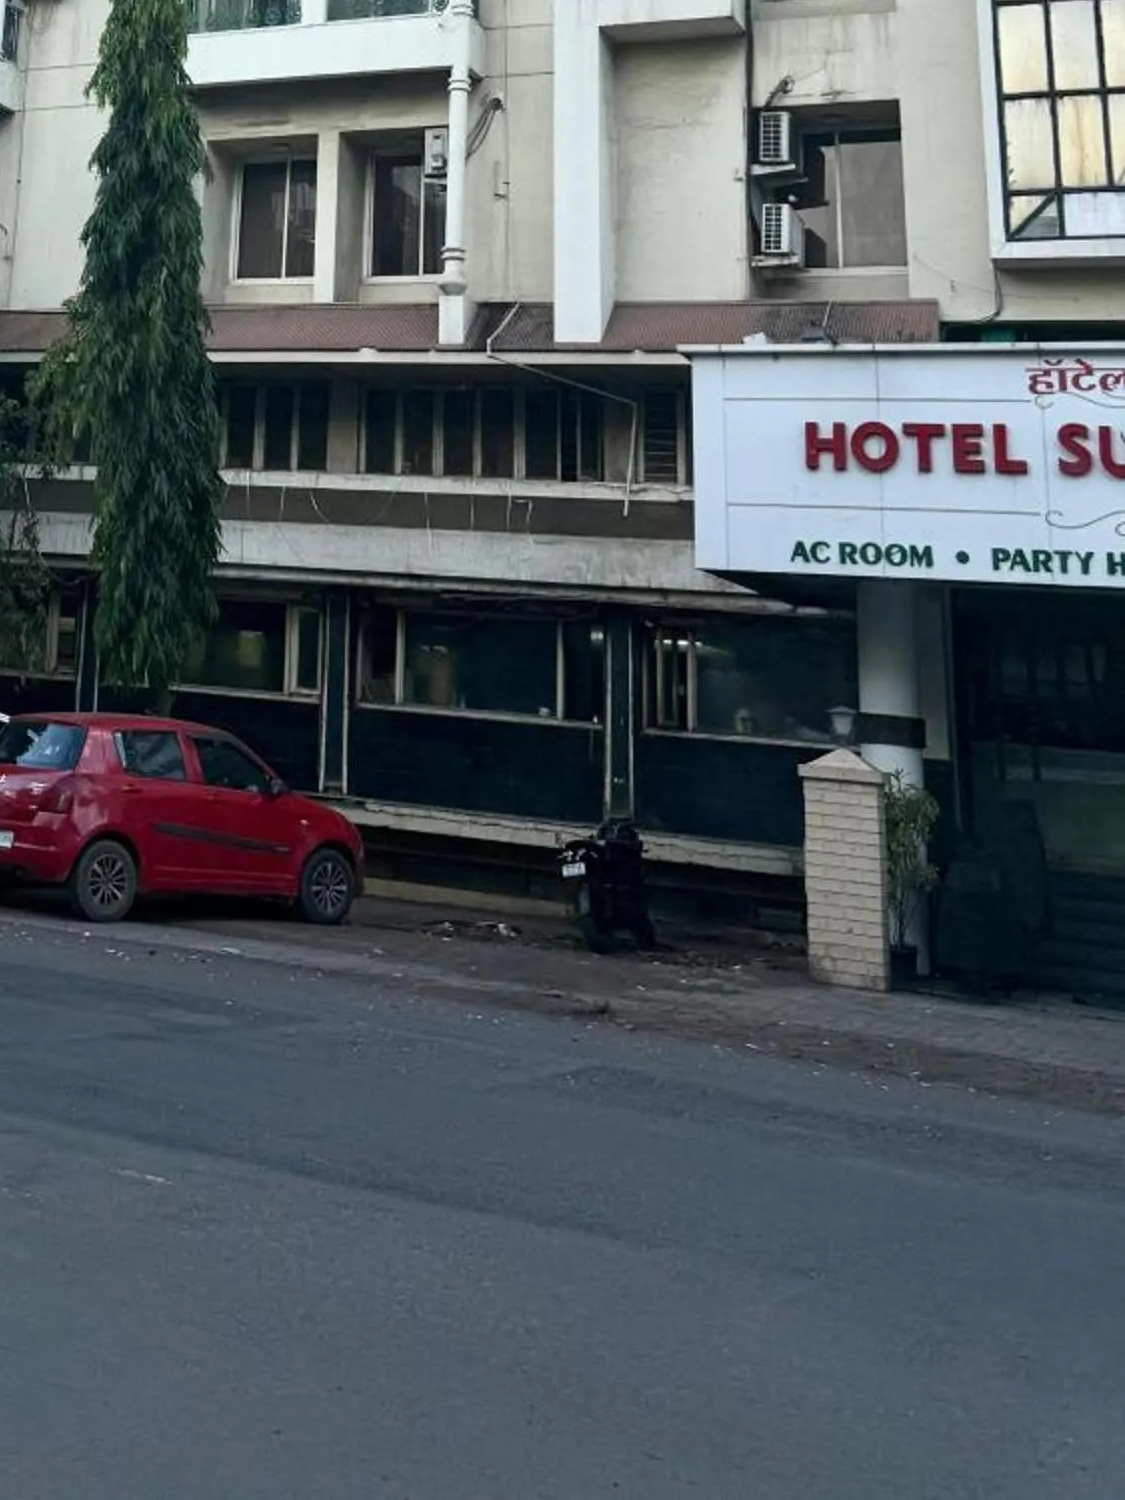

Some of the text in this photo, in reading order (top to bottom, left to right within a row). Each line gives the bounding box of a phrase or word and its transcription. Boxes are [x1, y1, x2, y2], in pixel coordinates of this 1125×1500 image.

[804, 421, 1028, 475] HOTEL
[791, 540, 830, 564] AC
[839, 541, 934, 568] ROOM
[991, 548, 1095, 576] PARTY
